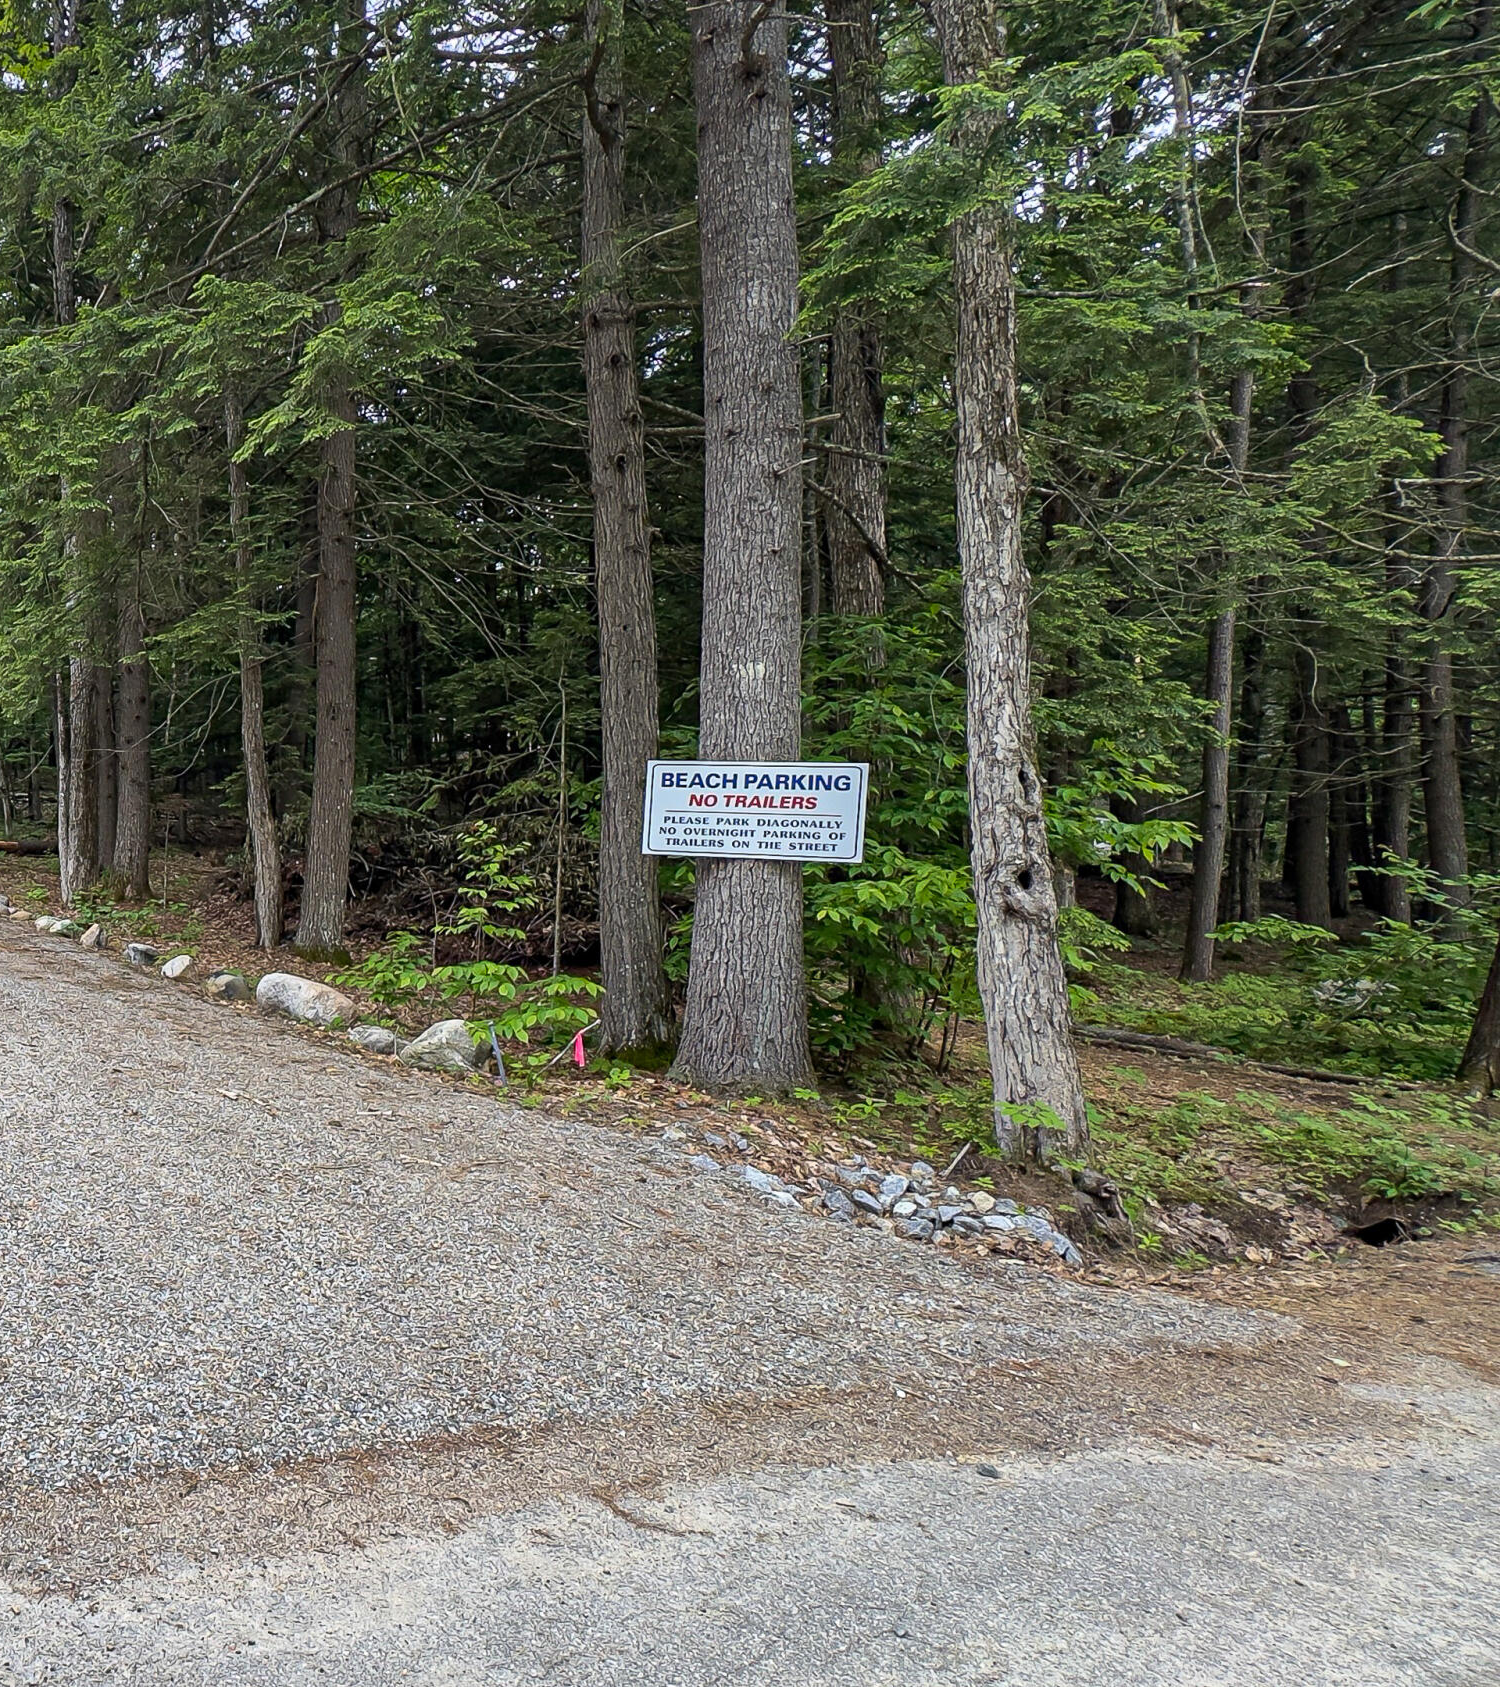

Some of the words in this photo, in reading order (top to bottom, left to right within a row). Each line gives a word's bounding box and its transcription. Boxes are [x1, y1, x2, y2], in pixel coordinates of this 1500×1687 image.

[661, 772, 738, 789] BEACH
[744, 773, 851, 791] PARKING
[689, 794, 718, 807] NO
[723, 795, 818, 810] TRAILERS
[663, 816, 710, 825] PLEASE
[716, 817, 750, 826] PARK
[756, 818, 843, 829] DIAGONALLY
[659, 826, 677, 835] NO
[683, 827, 756, 837] OVERNIGHT
[763, 830, 821, 840] PARKING
[828, 832, 847, 840] OF
[665, 837, 724, 847] TRAILERS
[731, 840, 750, 848] ON
[757, 841, 782, 850] THE
[788, 842, 838, 852] STREET
